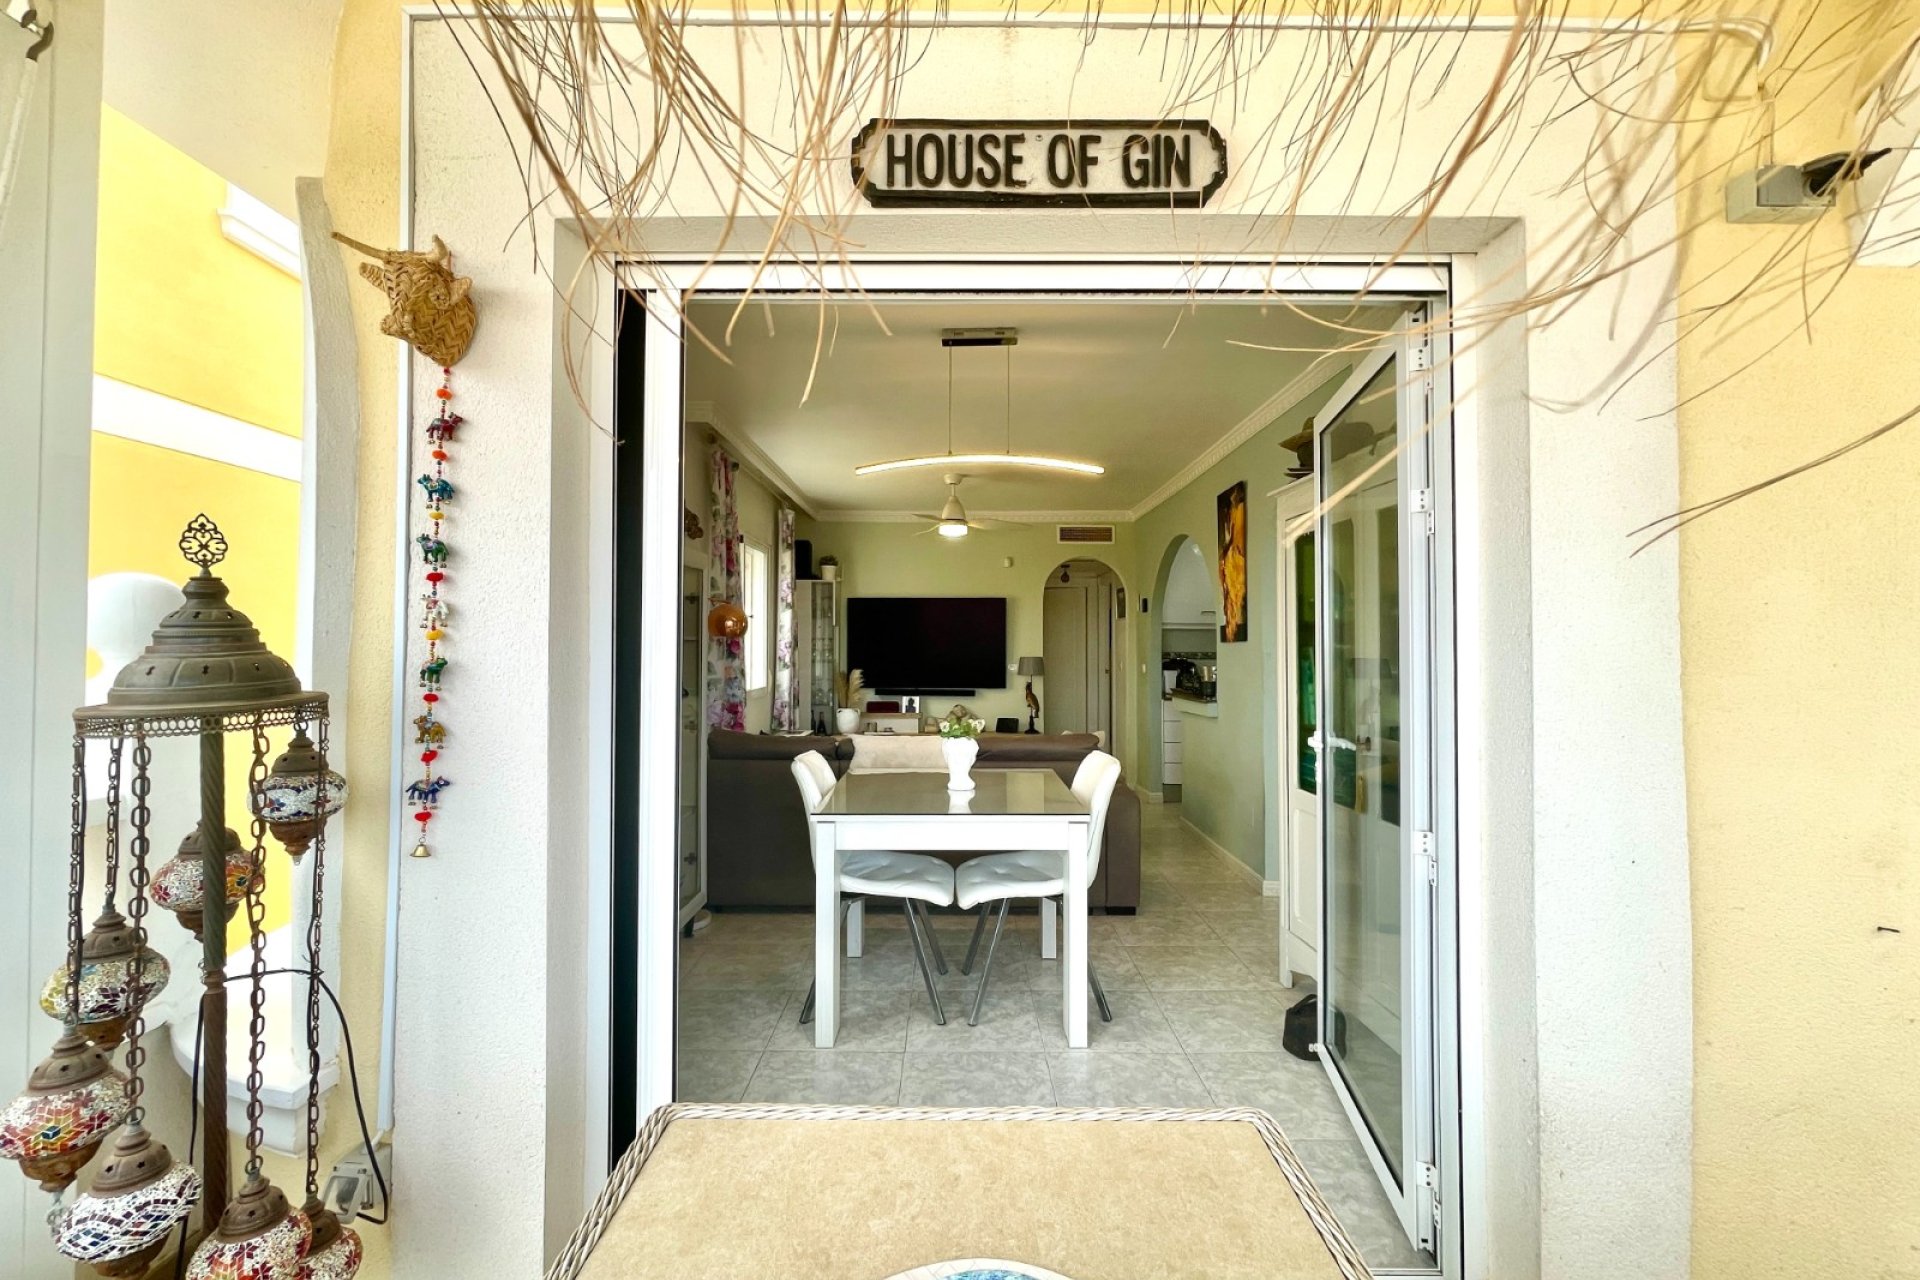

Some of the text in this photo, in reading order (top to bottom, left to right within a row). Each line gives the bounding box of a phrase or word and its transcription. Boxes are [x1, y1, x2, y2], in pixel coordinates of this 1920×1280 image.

[886, 133, 1191, 188] HOUSE OF GIN
